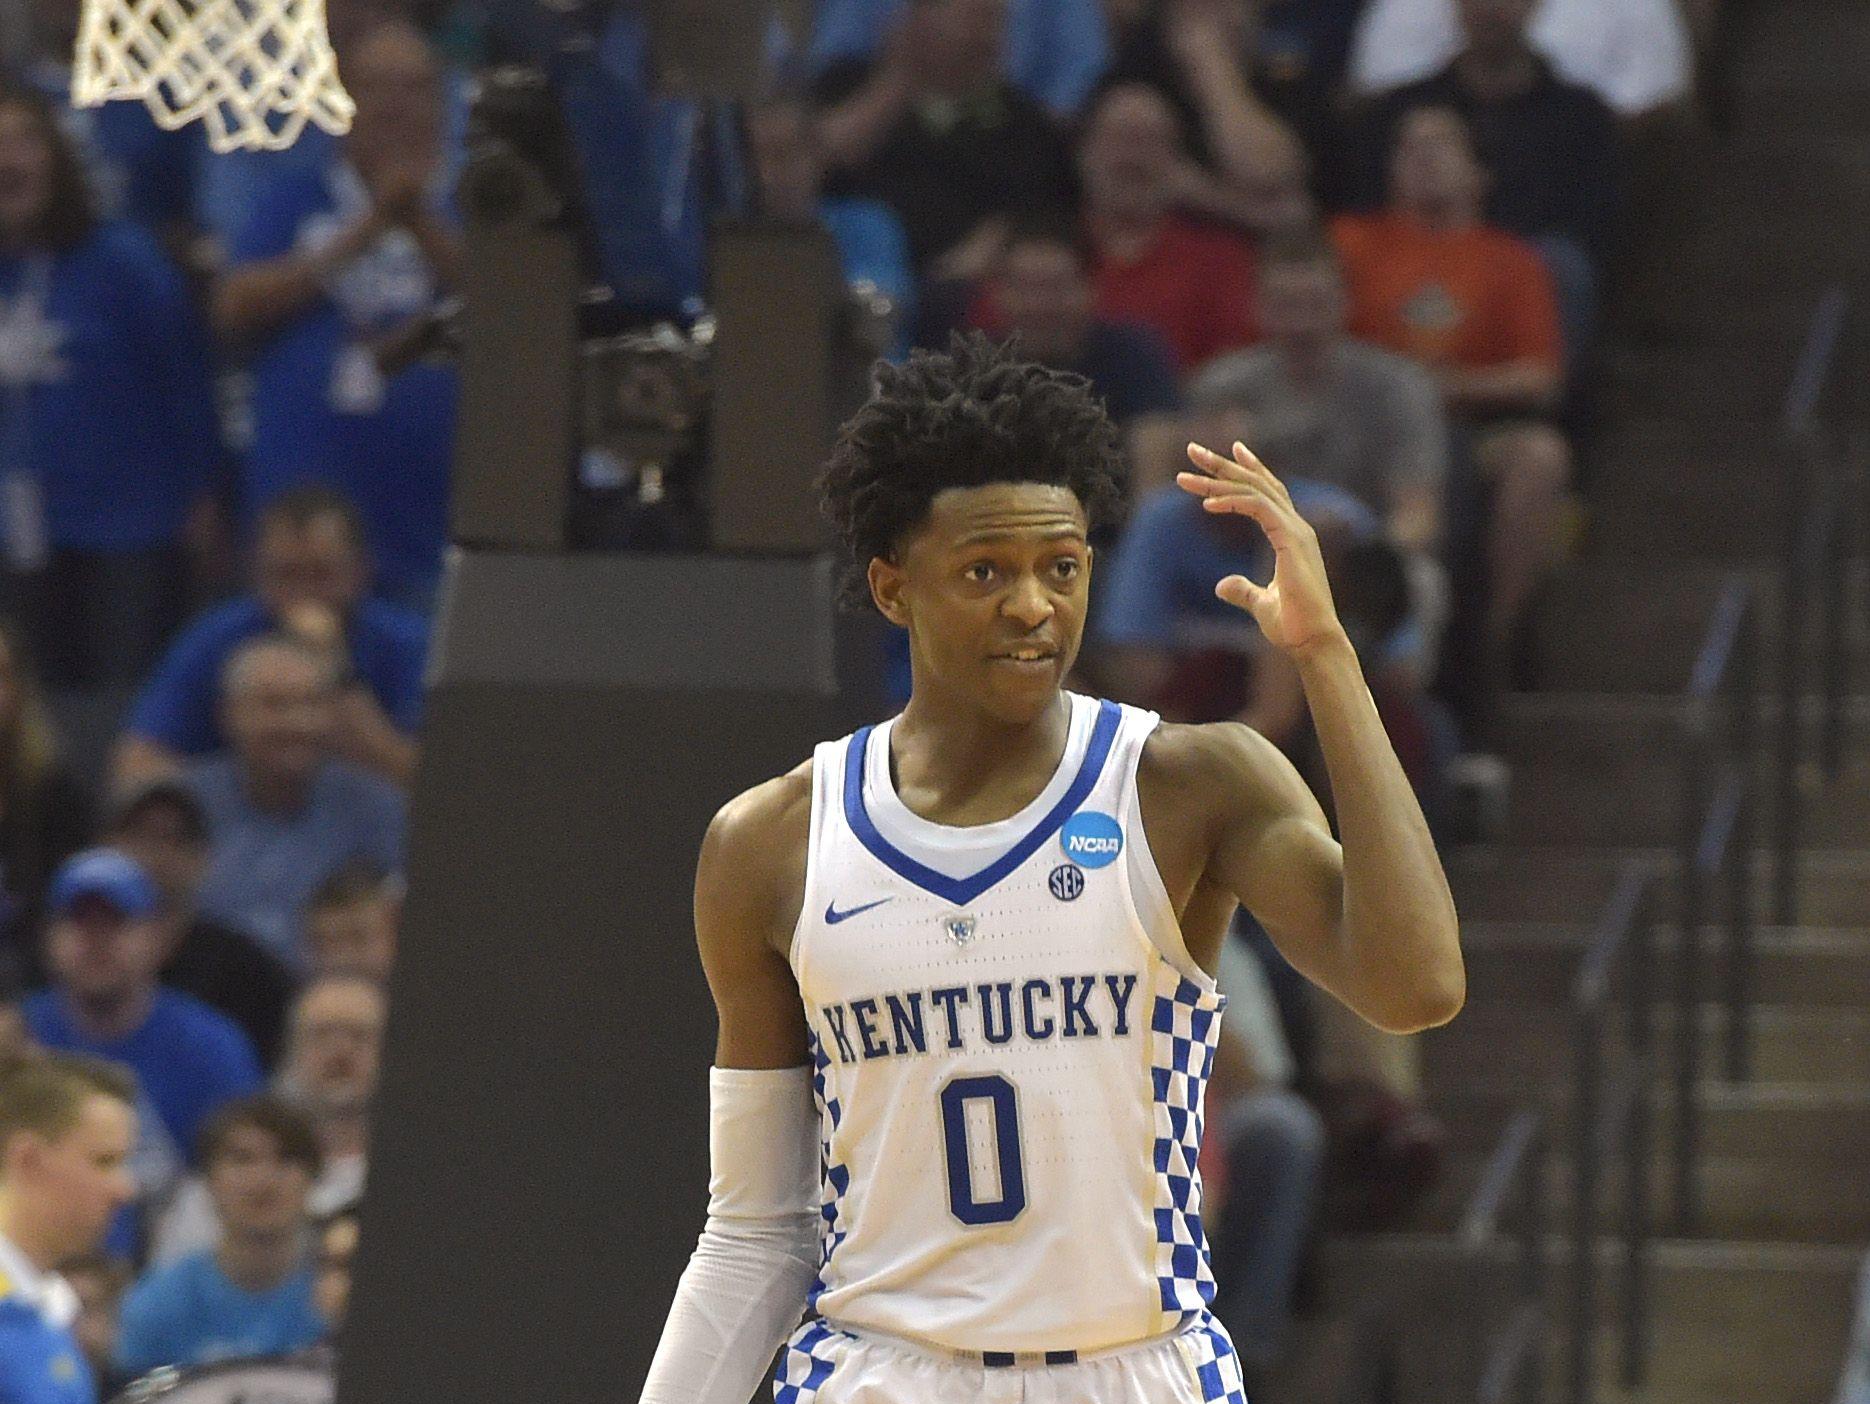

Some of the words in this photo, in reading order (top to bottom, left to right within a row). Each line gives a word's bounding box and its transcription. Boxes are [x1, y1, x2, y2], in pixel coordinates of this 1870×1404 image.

[1069, 835, 1119, 853] NCAA
[1050, 866, 1083, 899] SEC
[822, 974, 1137, 1063] KENTUCKY
[939, 1074, 1028, 1227] 0
